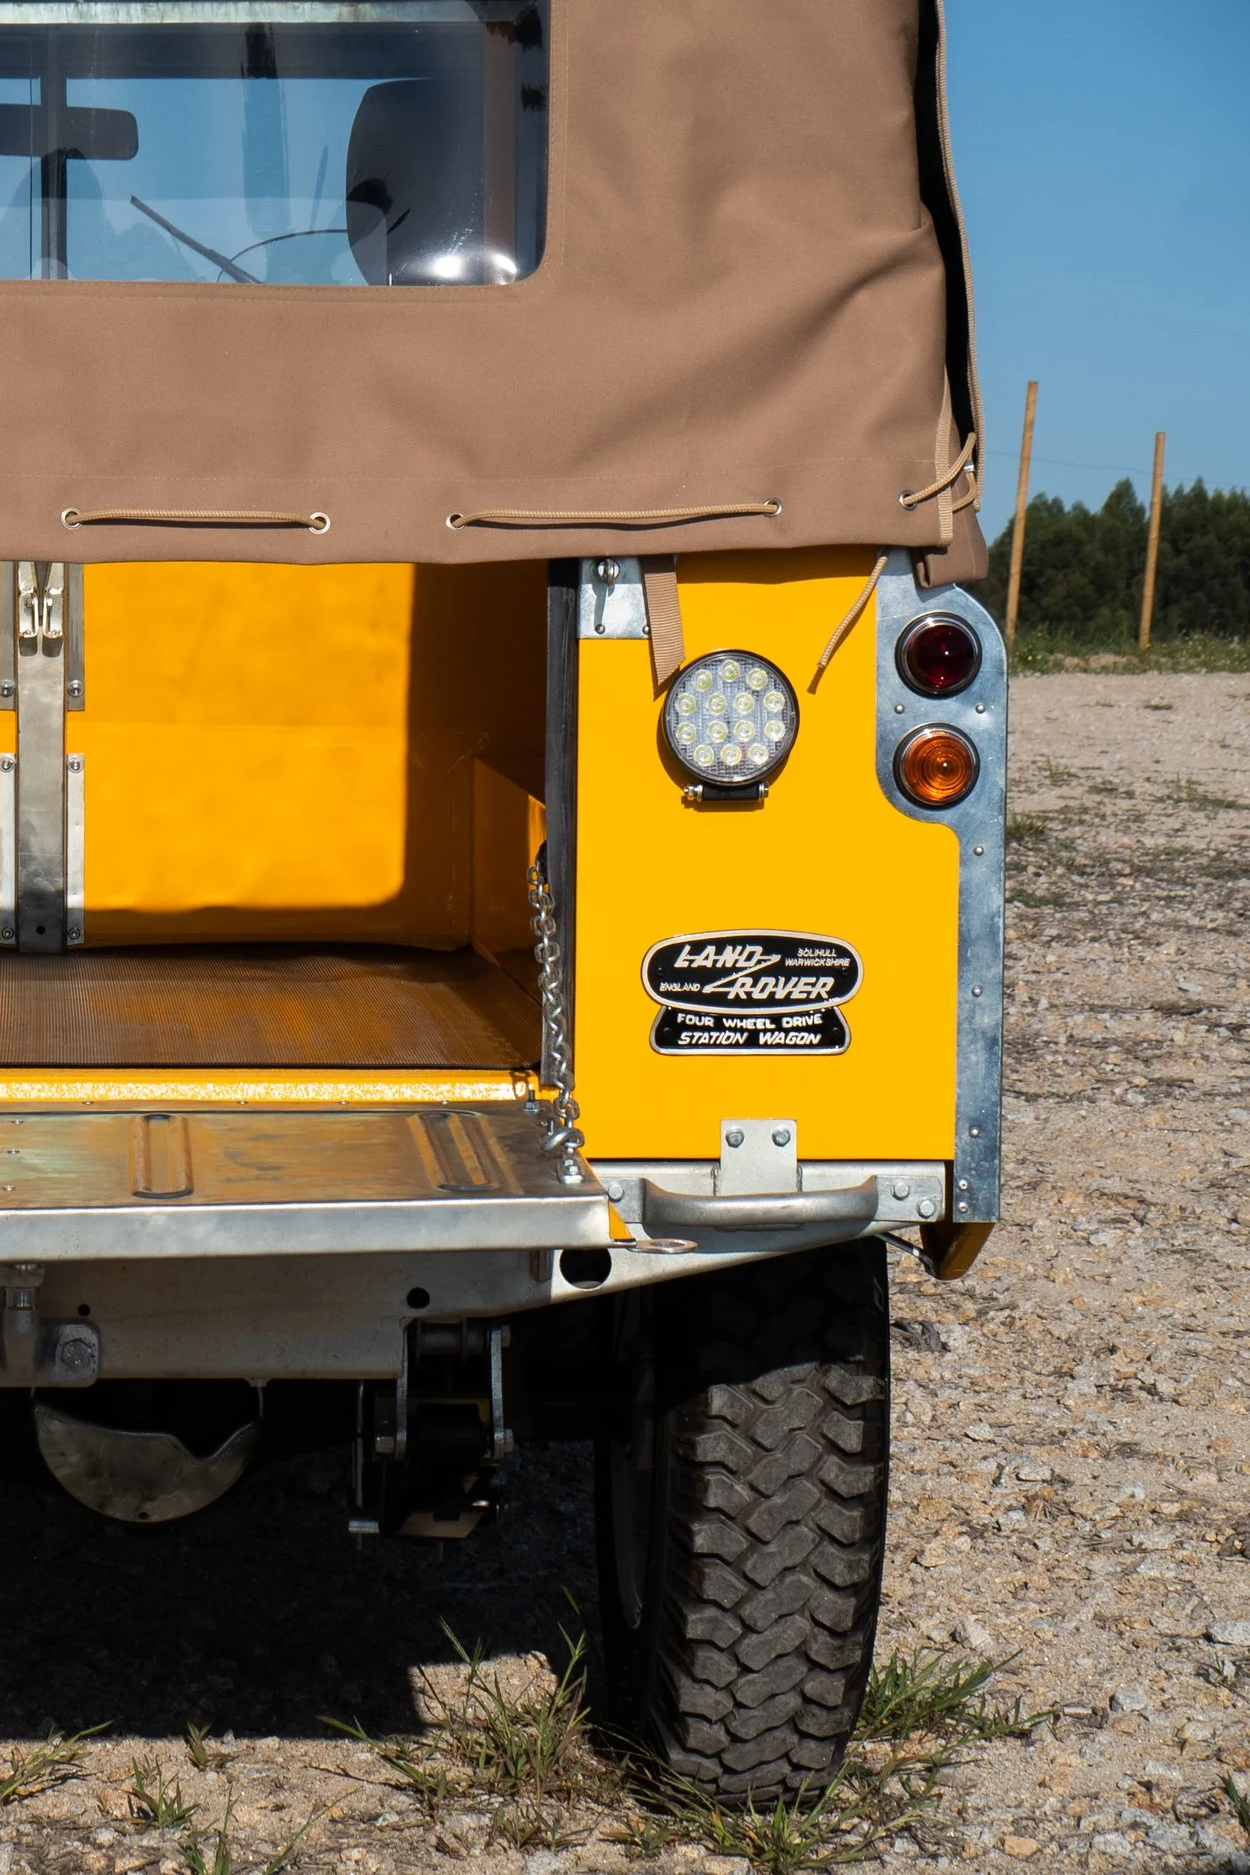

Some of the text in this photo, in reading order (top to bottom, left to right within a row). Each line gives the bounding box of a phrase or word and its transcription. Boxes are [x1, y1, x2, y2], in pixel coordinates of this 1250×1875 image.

[674, 944, 763, 968] LAND
[797, 948, 837, 957] SOLIHULL
[785, 957, 851, 967] WARWICKSHIRE
[659, 982, 701, 992] ENGLAND
[727, 976, 835, 999] ROVER
[677, 1013, 823, 1029] FOUR WHEEL DRIVE
[678, 1030, 823, 1045] STATION WAGON
